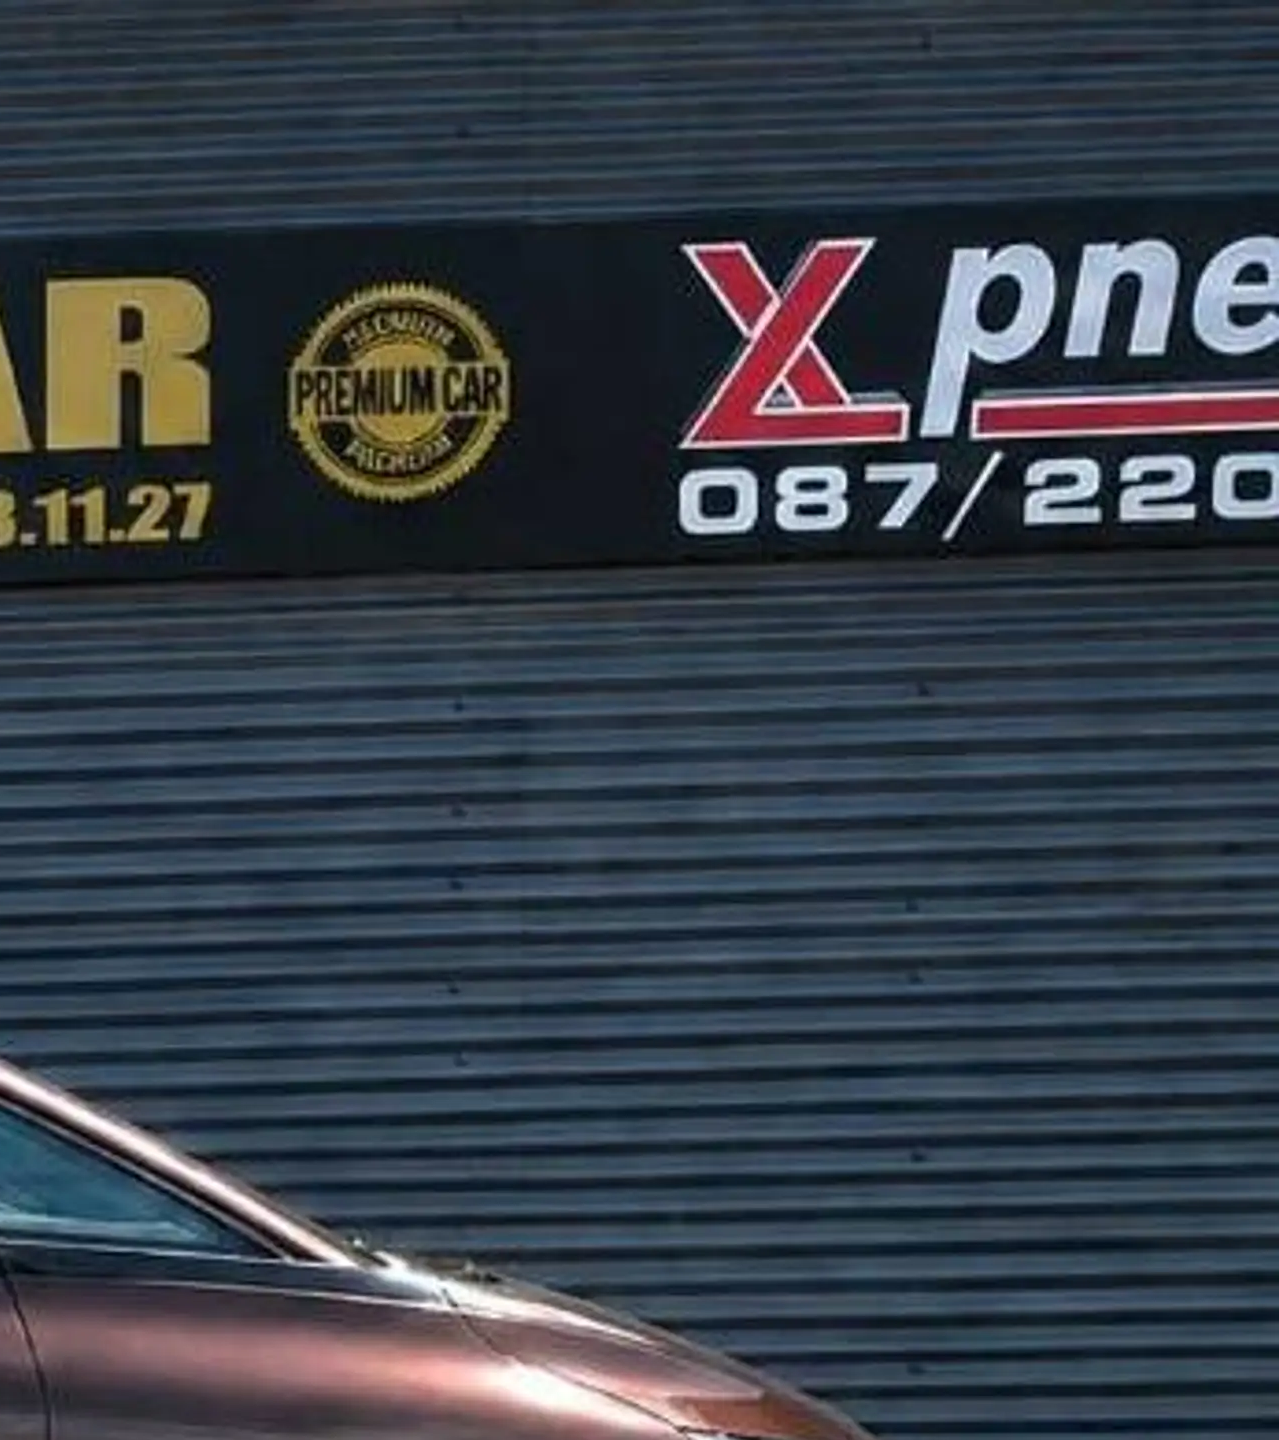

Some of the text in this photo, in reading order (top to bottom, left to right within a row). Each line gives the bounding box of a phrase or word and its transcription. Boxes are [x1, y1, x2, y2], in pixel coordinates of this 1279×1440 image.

[919, 234, 1279, 440] pne
[296, 364, 503, 417] PREMIUM CAR
[678, 450, 1279, 542] 087/220
